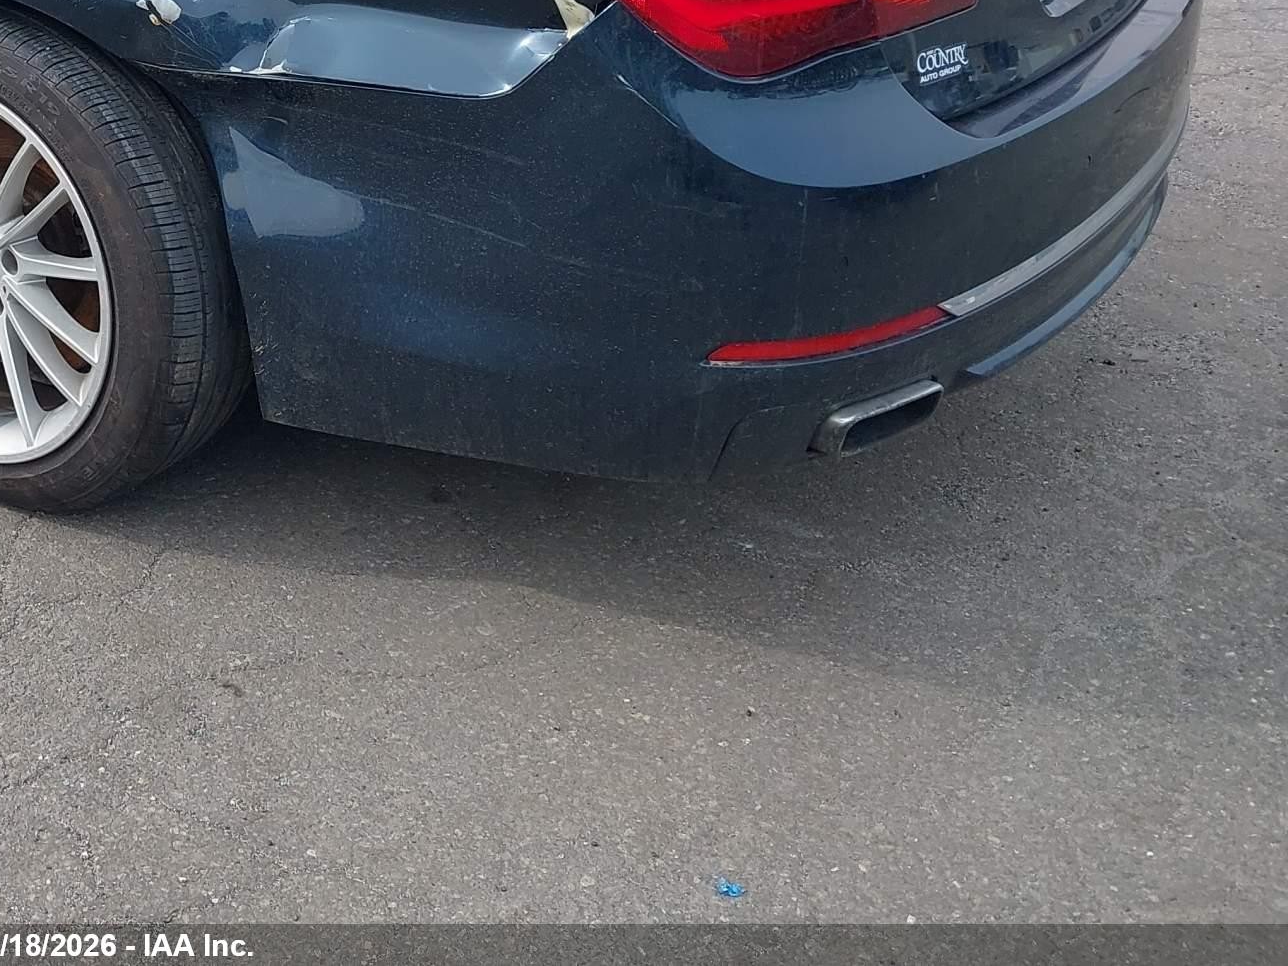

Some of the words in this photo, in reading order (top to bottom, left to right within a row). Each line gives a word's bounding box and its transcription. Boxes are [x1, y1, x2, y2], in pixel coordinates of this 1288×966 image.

[917, 44, 969, 73] COUNTRY
[920, 71, 939, 84] AUTO
[938, 64, 962, 77] GROUP
